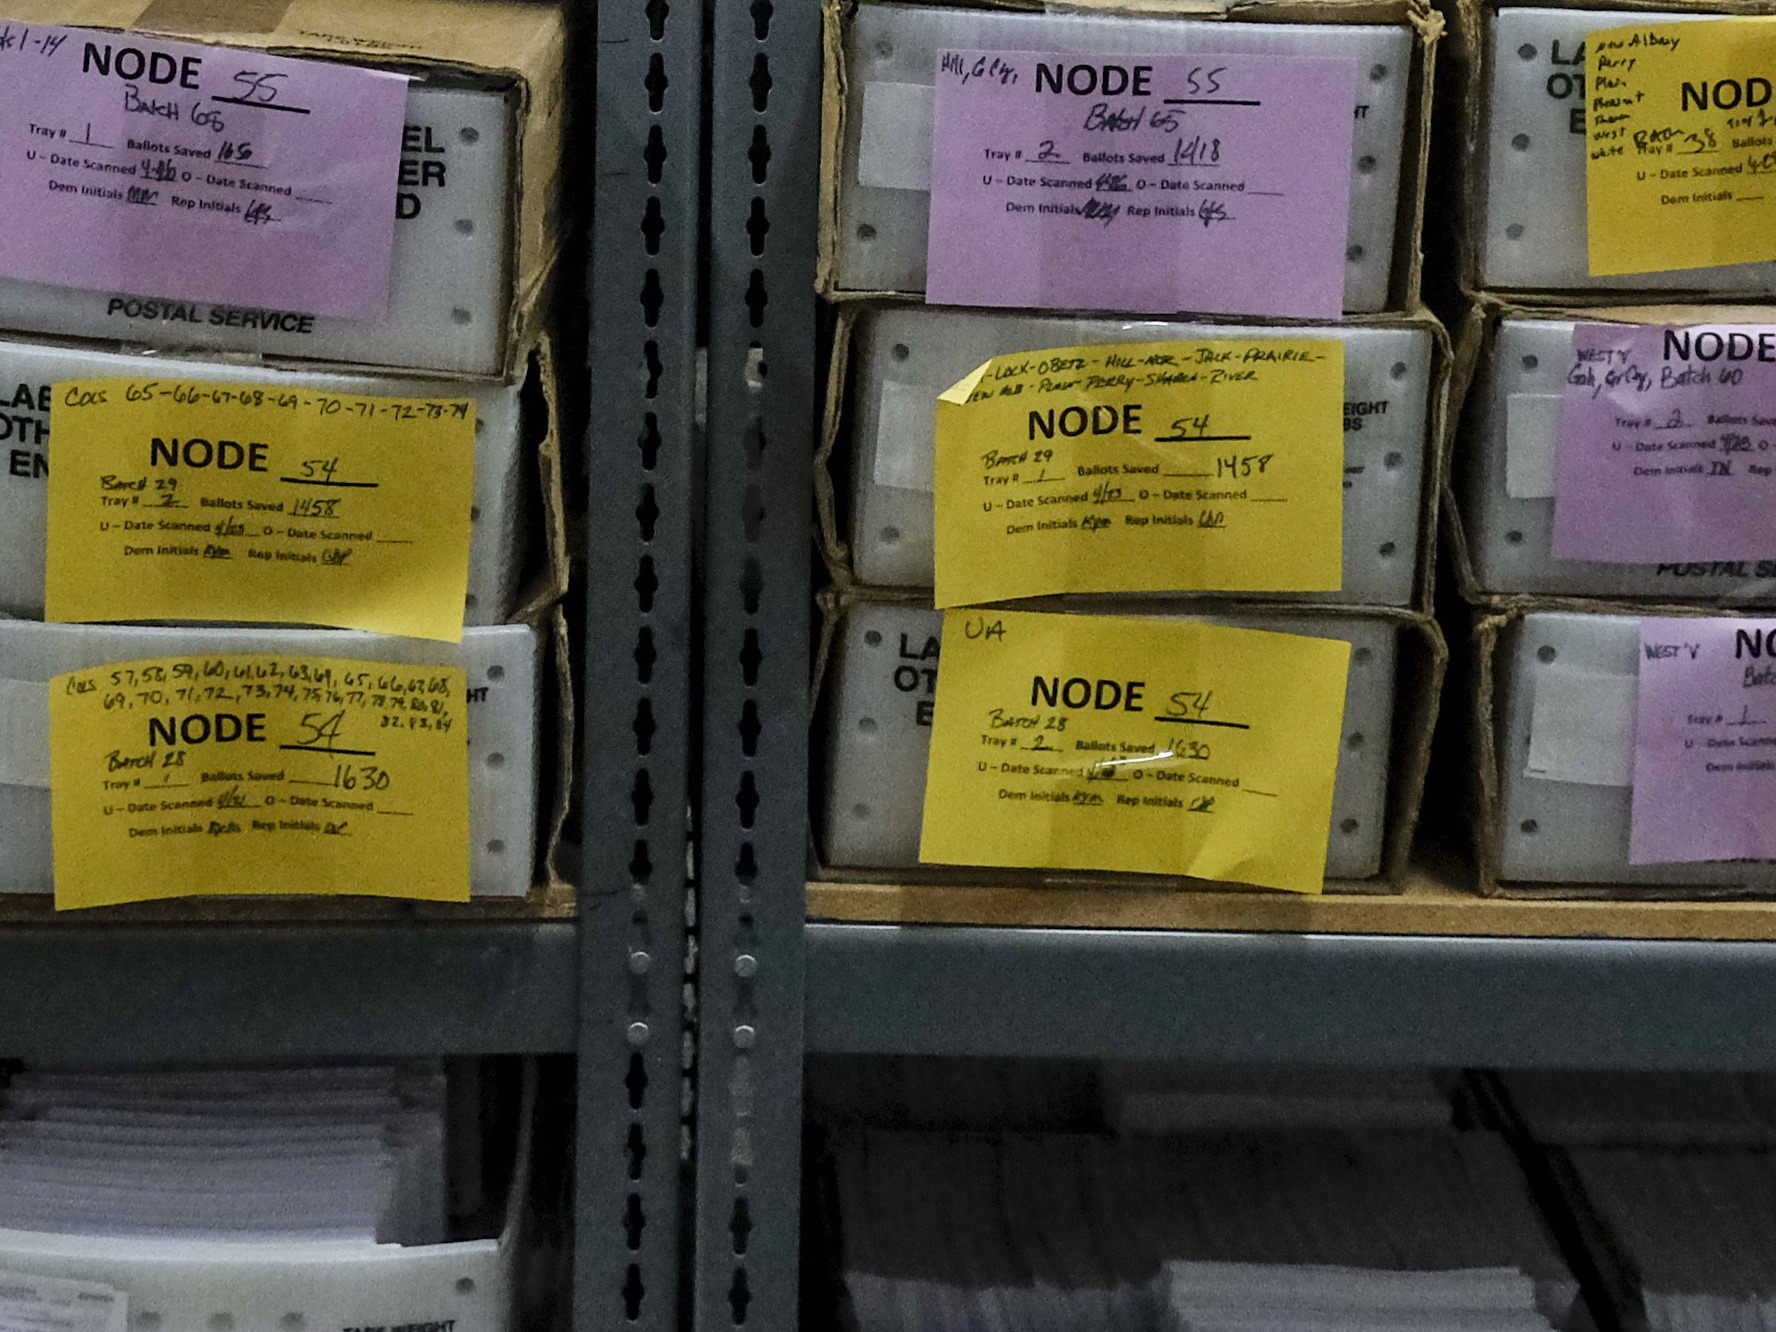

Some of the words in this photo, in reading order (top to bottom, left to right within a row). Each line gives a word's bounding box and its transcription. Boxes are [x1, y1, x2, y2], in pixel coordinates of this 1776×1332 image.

[83, 43, 201, 89] NODE
[233, 71, 289, 103] 55
[1036, 63, 1152, 96] NODE
[1186, 69, 1223, 96] 55
[108, 298, 202, 323] POSTAL
[209, 306, 315, 334] SERVICE
[1664, 330, 1776, 362] NODE
[1029, 405, 1142, 440] NODE
[1170, 416, 1208, 439] 54
[1032, 676, 1145, 711] NODE
